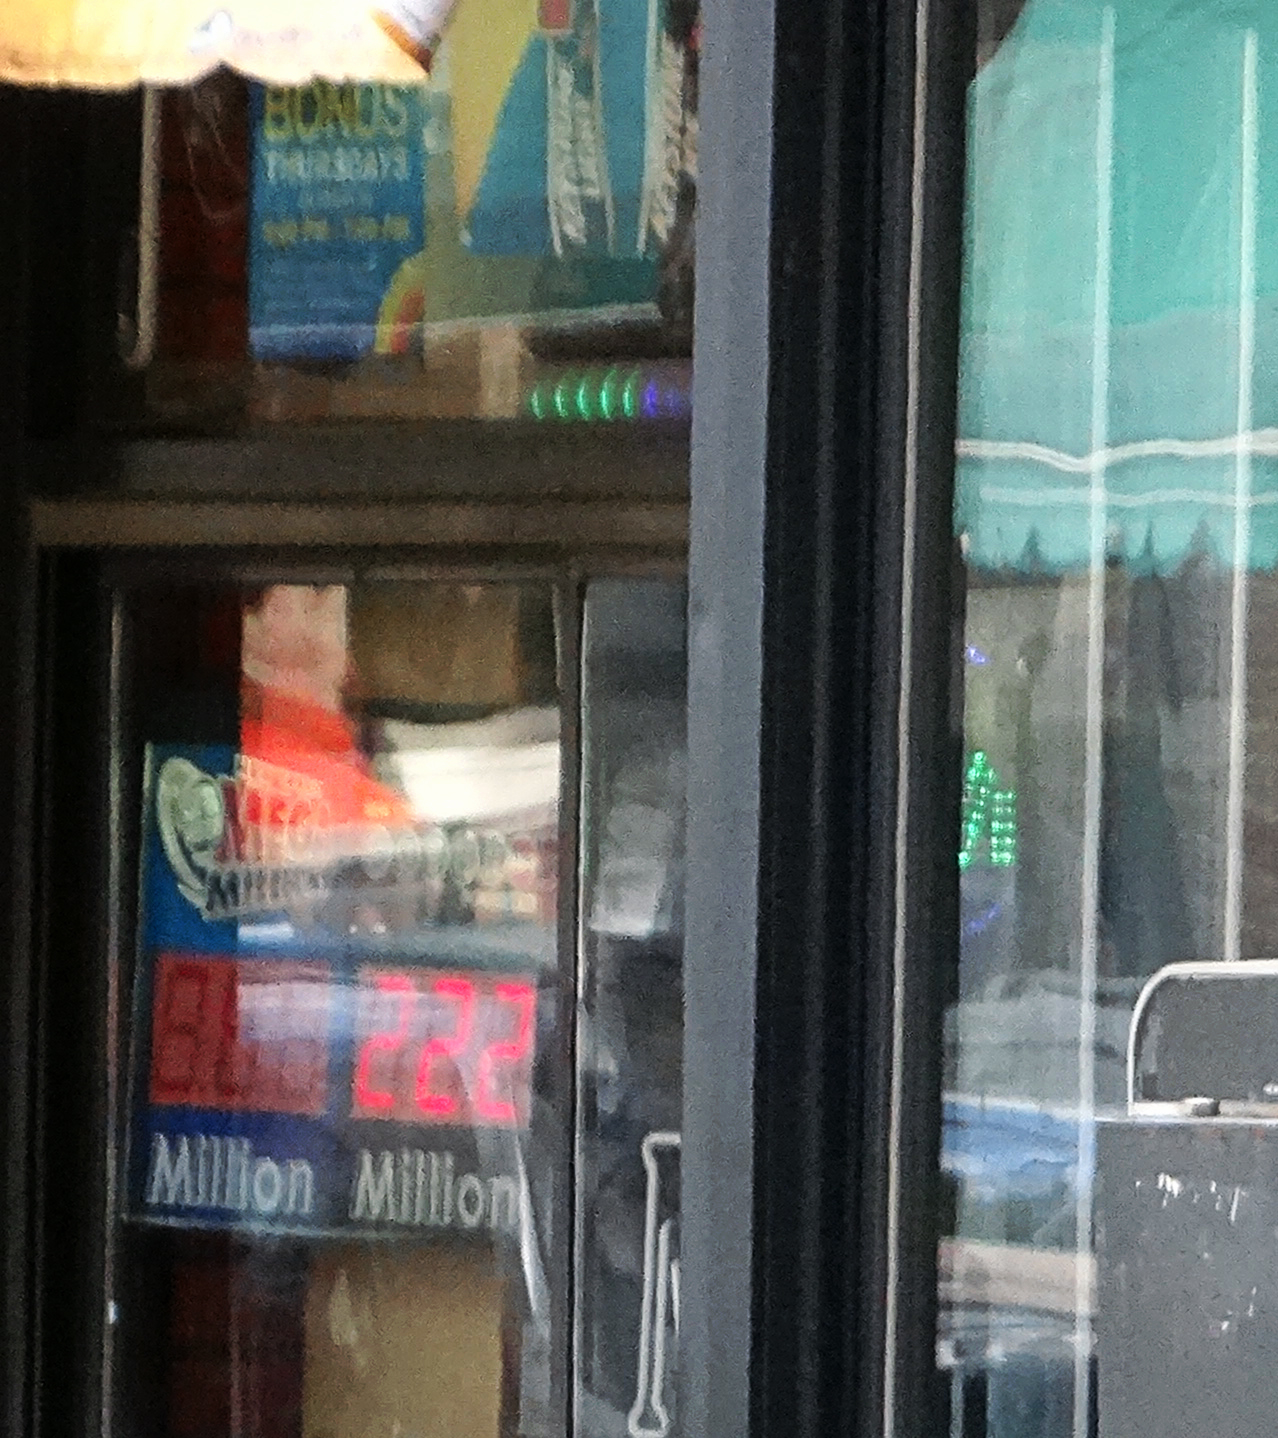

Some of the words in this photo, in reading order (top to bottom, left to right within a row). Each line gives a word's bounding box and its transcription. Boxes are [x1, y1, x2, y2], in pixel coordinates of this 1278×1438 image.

[263, 85, 409, 143] BONUS
[353, 975, 538, 1120] 222
[146, 1133, 315, 1214] Million
[349, 1148, 522, 1227] Million
